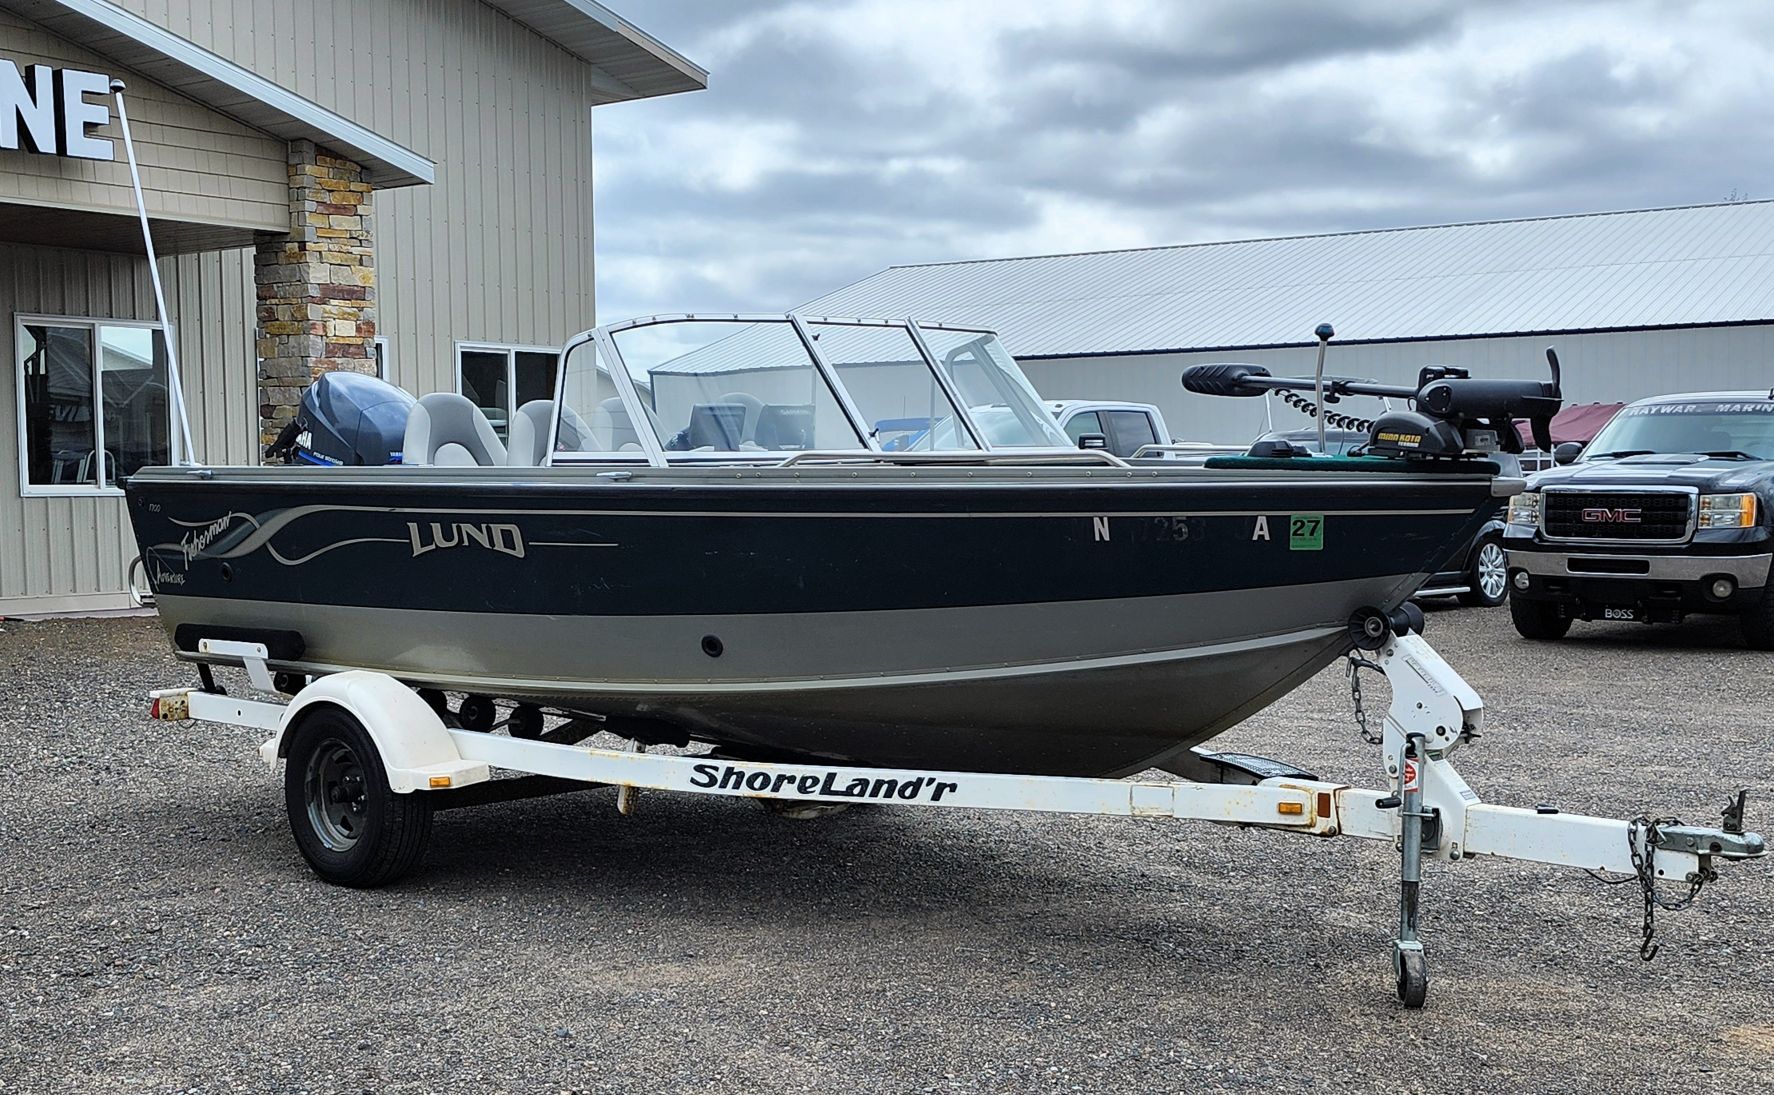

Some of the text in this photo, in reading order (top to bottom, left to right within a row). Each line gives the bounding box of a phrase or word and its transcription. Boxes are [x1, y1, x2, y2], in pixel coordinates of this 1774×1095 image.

[1628, 403, 1774, 416] HAYWAR MARIN
[1399, 433, 1421, 443] KOTA
[1582, 508, 1642, 523] GMC
[1292, 519, 1321, 537] 27
[406, 522, 525, 559] LUND
[1604, 608, 1634, 619] BOSS
